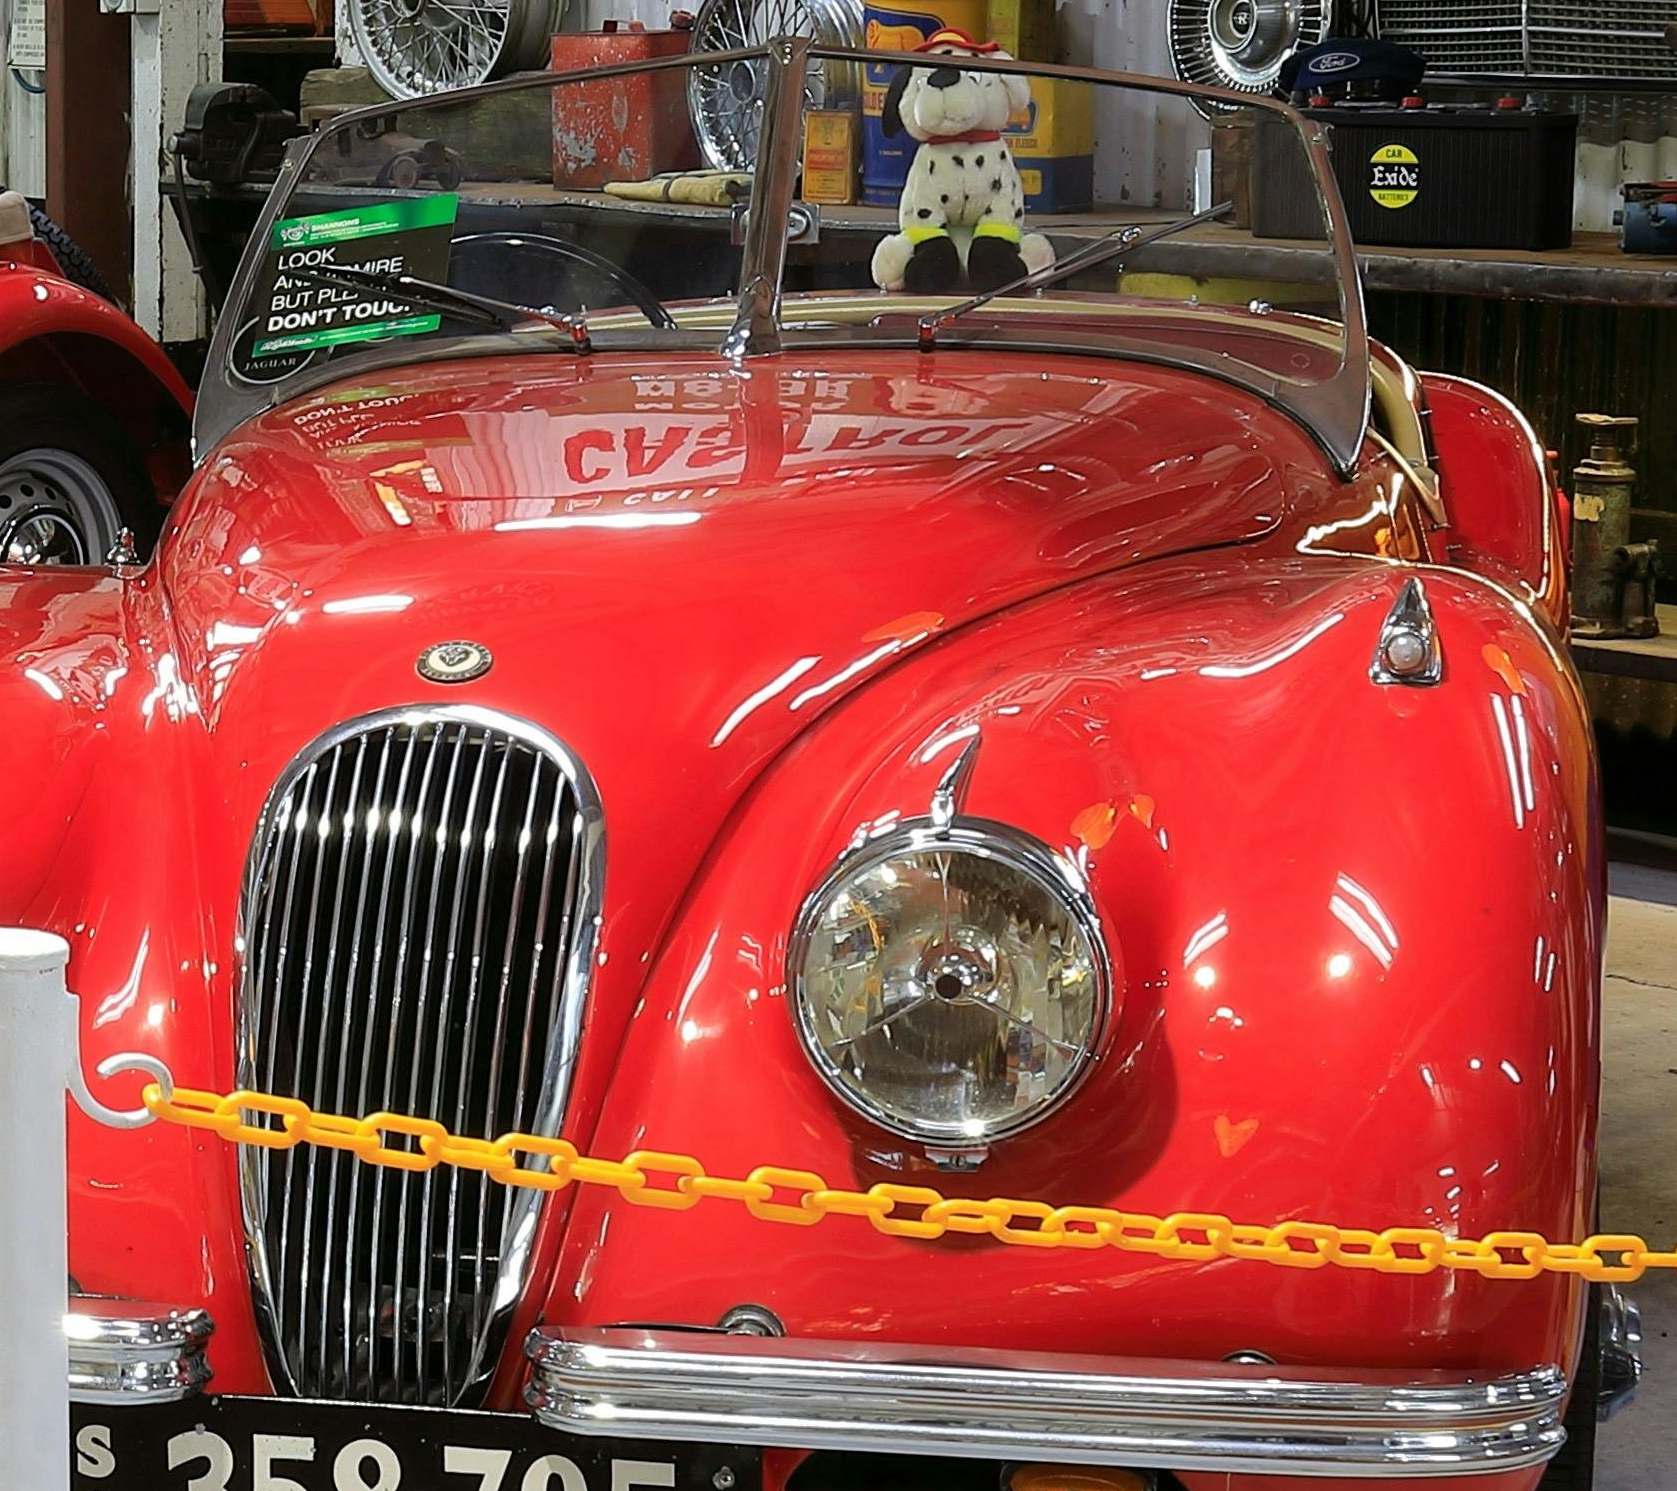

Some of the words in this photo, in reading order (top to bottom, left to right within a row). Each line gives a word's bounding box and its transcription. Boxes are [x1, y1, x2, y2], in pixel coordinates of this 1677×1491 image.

[1319, 56, 1346, 70] Ford
[1386, 149, 1402, 159] CAR
[1370, 165, 1418, 187] Exide
[278, 247, 337, 271] LOOK
[271, 291, 314, 311] BUT
[268, 307, 337, 332] DON'T
[245, 357, 297, 372] JAGUAR
[76, 1426, 116, 1478] S
